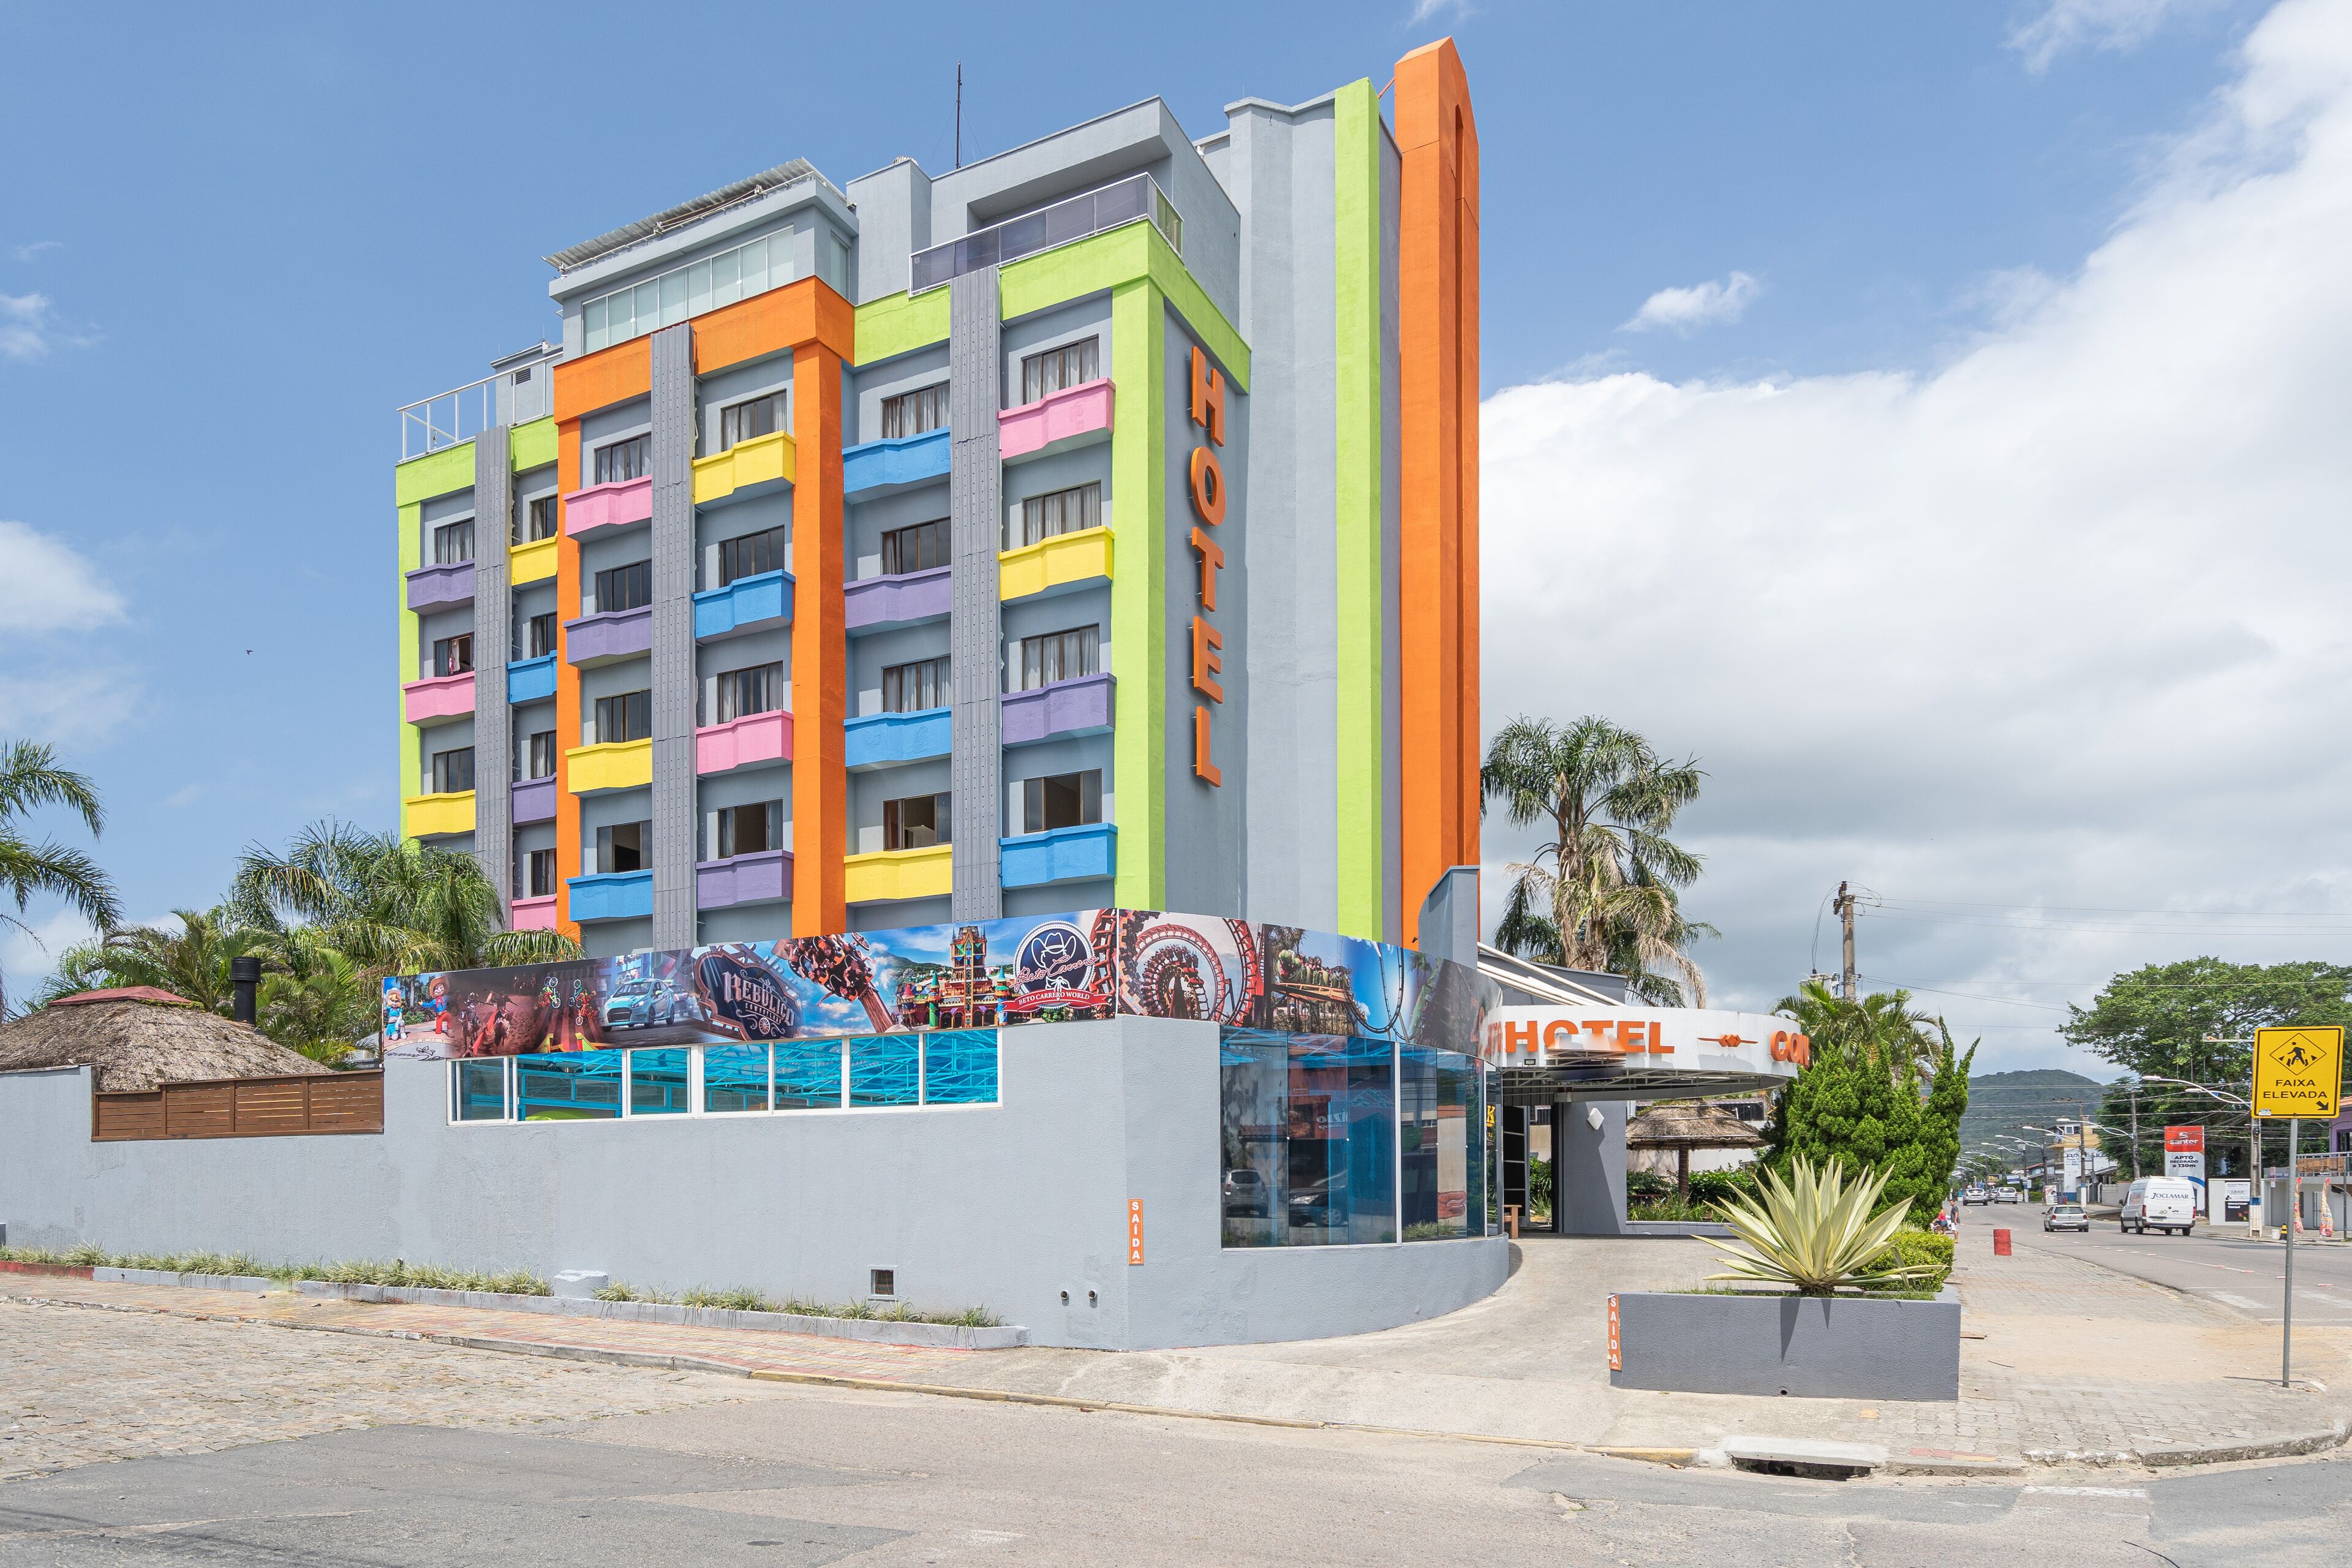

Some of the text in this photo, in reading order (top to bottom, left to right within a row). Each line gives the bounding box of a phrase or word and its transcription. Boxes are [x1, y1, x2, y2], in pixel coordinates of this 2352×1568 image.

[1191, 346, 1226, 788] HOTEL
[1009, 955, 1099, 992] Beto Carrero
[1019, 995, 1035, 1005] BETO
[1036, 992, 1065, 1001] CARRERO
[1132, 1201, 1140, 1259] SAÍDA
